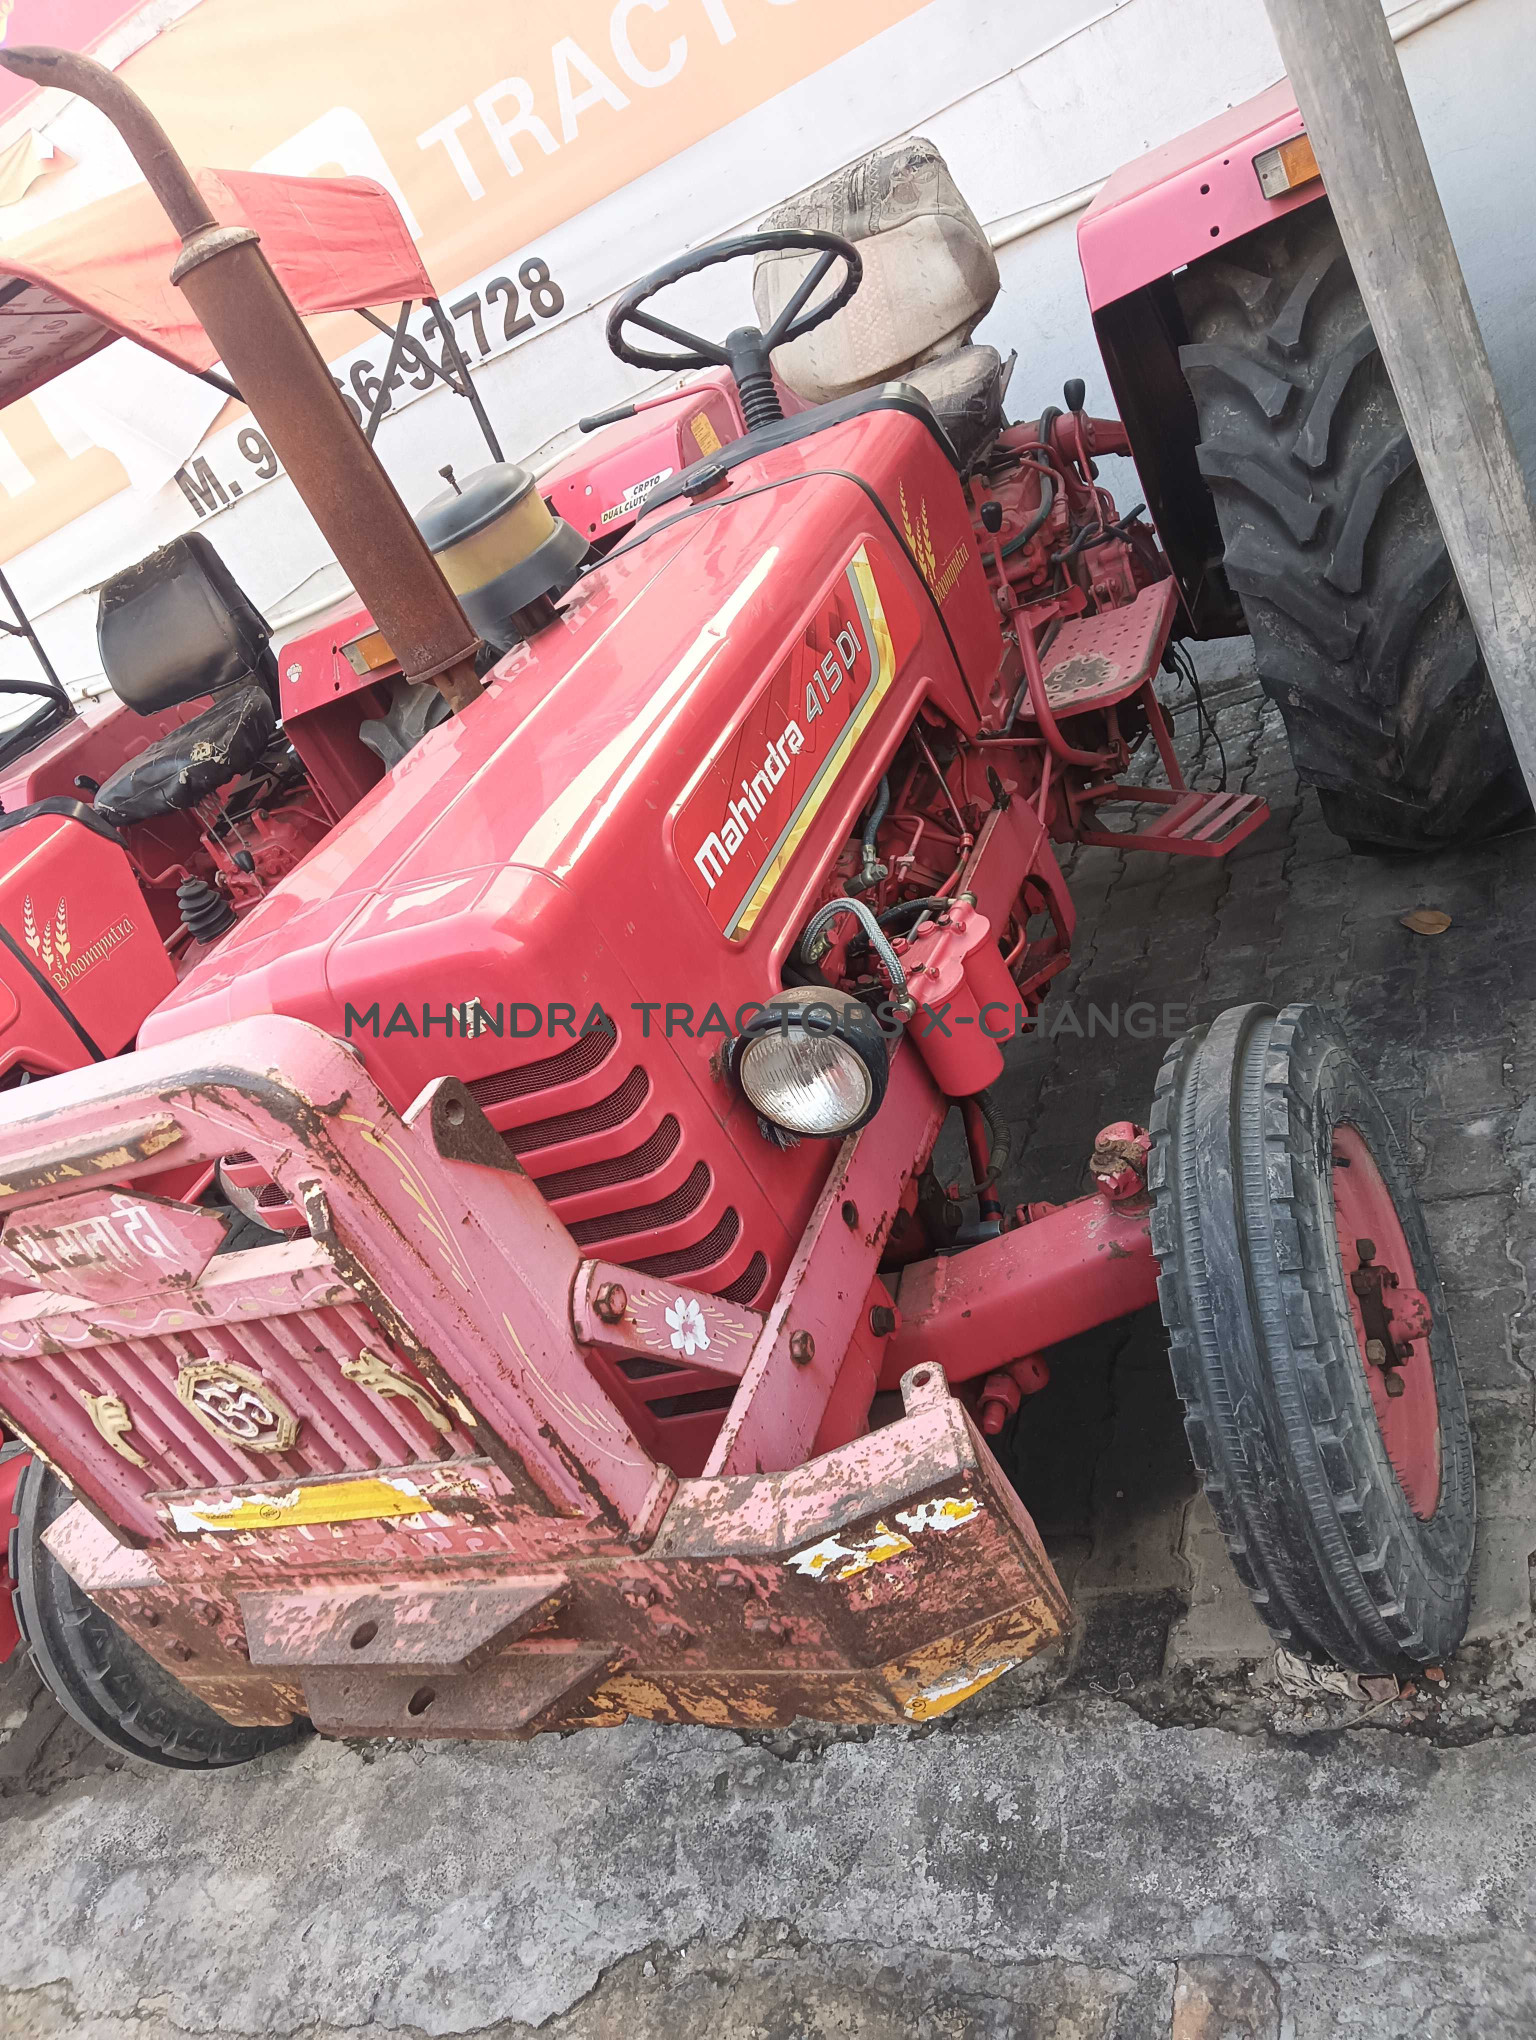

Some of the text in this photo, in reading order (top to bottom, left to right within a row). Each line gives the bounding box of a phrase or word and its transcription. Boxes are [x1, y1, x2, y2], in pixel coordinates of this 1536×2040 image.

[414, 0, 798, 202] TRAC
[174, 455, 244, 518] M.
[602, 505, 623, 522] DUAL
[694, 621, 862, 889] Mahindra 415 DI
[51, 917, 134, 991] Bhoomiputra
[109, 1193, 182, 1265] दी
